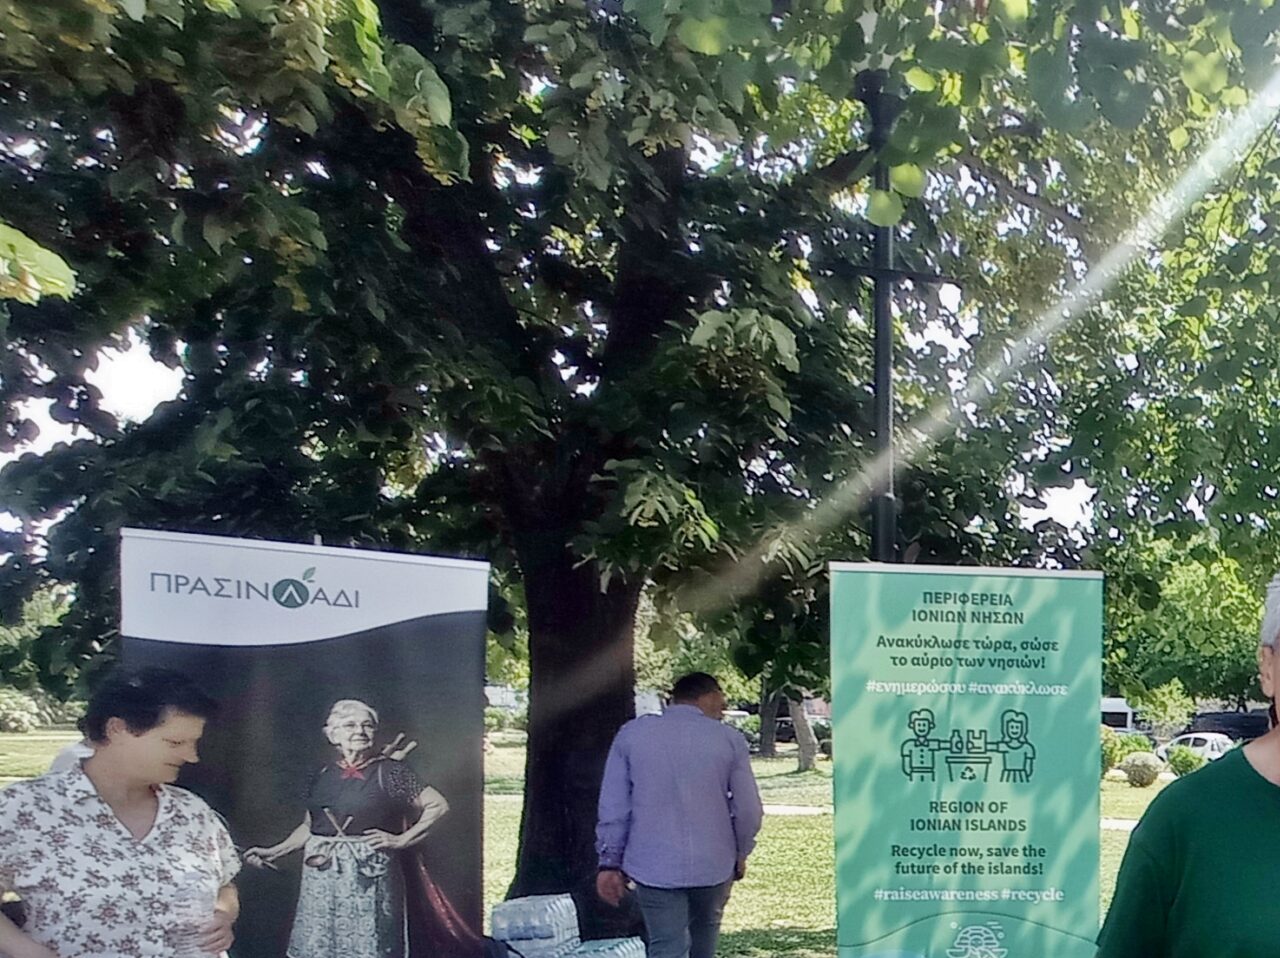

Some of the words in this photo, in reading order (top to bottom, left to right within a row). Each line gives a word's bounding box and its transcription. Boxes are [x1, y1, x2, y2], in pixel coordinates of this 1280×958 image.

[923, 591, 1014, 606] ΠΕΡΙΦΕΡΕΙΑ
[912, 609, 967, 623] ΙΟΝΙΩΝ
[971, 611, 1024, 624] ΝΗΣΩΝ
[876, 633, 970, 650] Ανακύκλωσε
[973, 635, 1017, 653] τώρα,
[1020, 636, 1060, 652] σώσε
[890, 655, 908, 667] το
[911, 652, 954, 670] αύριο
[956, 657, 986, 668] των
[988, 654, 1046, 671] νησιών!
[866, 678, 966, 695] #ενημερώσου
[967, 680, 1069, 696] #ανακύκλωσε
[929, 801, 984, 814] REGION
[988, 801, 1009, 814] OF
[910, 819, 961, 832] IONIAN
[965, 819, 1027, 832] ISLANDS
[891, 844, 947, 860] Recycle
[949, 847, 984, 860] now,
[986, 847, 1019, 857] save
[1022, 844, 1046, 858] the
[895, 861, 940, 875] future
[943, 861, 959, 875] of
[961, 862, 985, 876] the
[988, 861, 1044, 876] islands!
[874, 886, 999, 901] #raiseawareness
[1001, 887, 1065, 905] #recycle
